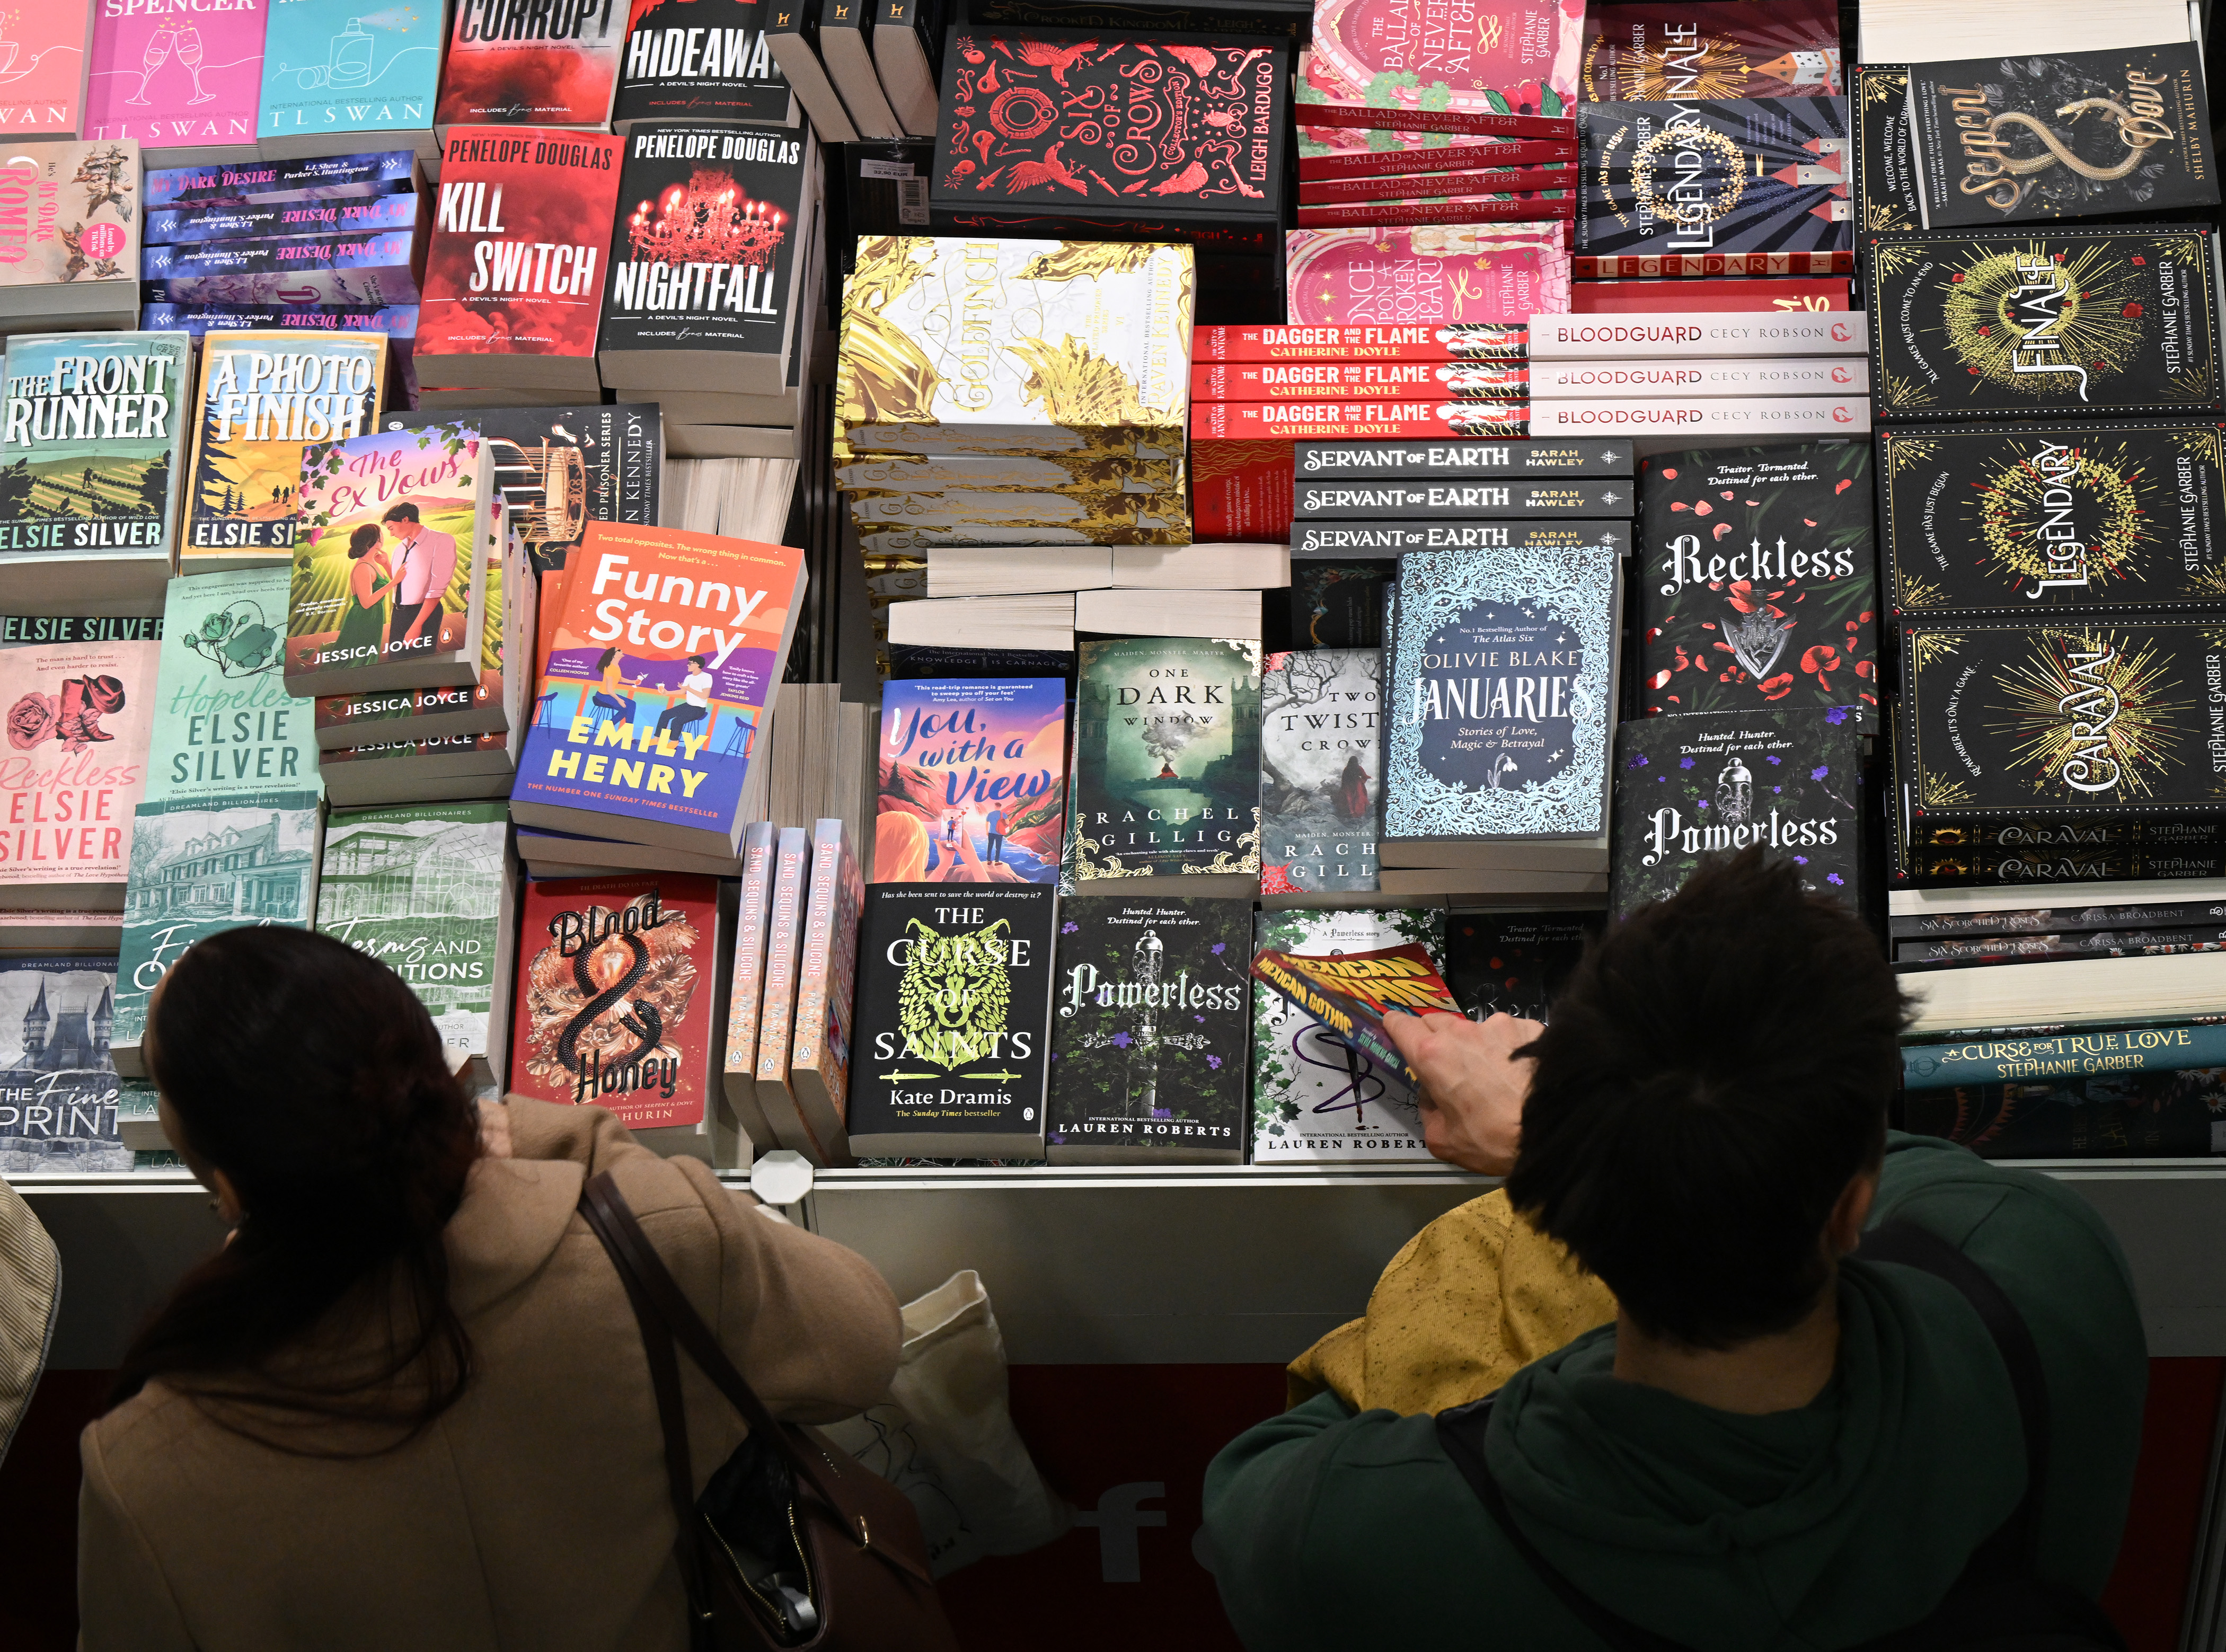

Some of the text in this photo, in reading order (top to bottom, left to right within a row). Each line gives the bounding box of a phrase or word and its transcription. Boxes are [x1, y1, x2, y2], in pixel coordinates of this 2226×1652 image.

[460, 0, 609, 43] CORRUPT
[626, 28, 782, 79] HIDEAWA
[270, 100, 332, 110] INTERNATIONAL
[270, 104, 422, 127] T L SWAN
[1059, 60, 1162, 175] SIX OF CROWS
[1250, 63, 1273, 181] LEIGH BARDUGO
[1338, 108, 1397, 120] BALLAD
[1408, 111, 1463, 125] NEVER
[1466, 114, 1517, 127] AFTER
[1374, 119, 1470, 133] STEPHANIE GARBER
[1937, 70, 2173, 209] Serpent Dove
[2180, 69, 2204, 180] SHELBY MAHURIN
[634, 135, 800, 165] PENELOPE DOUGLAS
[152, 170, 277, 194] MY DARK DESIRE
[1665, 102, 1713, 249] LEGENDARY
[30, 181, 59, 242] MY DARK
[437, 182, 505, 233] KILL
[469, 241, 596, 296] SWITCH
[613, 261, 776, 315] NIGHTFALL
[954, 242, 999, 412] GOLDFINCH
[1147, 256, 1174, 406] RAVEN KENNEDY
[2009, 255, 2088, 402] FINALE
[2159, 261, 2180, 373] STEPHANIE GARBER
[1262, 328, 1340, 344] DAGGER
[1366, 328, 1429, 343] FLAME
[1271, 347, 1400, 357] CATHERINE DOYLE
[1558, 326, 1823, 345] BLOODGUARD CECY ROBSON
[8, 355, 176, 399] THE FRONT
[211, 354, 373, 401] A PHOTO
[4, 393, 170, 448] RUNNER
[218, 393, 365, 441] FINISH
[348, 449, 402, 479] The
[1304, 447, 1509, 471] SERVANT OF EARTH
[1525, 458, 1585, 466] HAWLEY
[329, 451, 461, 518] Ex Vows
[0, 523, 160, 550] ELSIE SILVER
[196, 524, 263, 546] ELSIE
[2026, 439, 2088, 599] LEGENDARY
[613, 536, 633, 544] total
[634, 538, 674, 550] opposites.
[693, 546, 717, 557] wrong
[719, 548, 739, 560] thing
[750, 555, 786, 566] common.
[1660, 534, 1854, 596] Reckless
[591, 553, 767, 627] Funny
[313, 635, 433, 665] JESSICA JOYCE
[588, 599, 746, 670] Story
[1150, 669, 1188, 678] ONE
[1424, 651, 1578, 668] OLIVIE BLAKE
[1117, 684, 1224, 705] DARK
[1403, 675, 1591, 723] JANUARIES
[188, 710, 289, 746] ELSIE
[888, 708, 986, 757] You,
[1124, 716, 1214, 726] WINDOW
[1458, 727, 1538, 737] Stories of Love,
[2059, 643, 2121, 791] CARAVAL
[567, 715, 709, 761] EMILY
[919, 737, 1024, 766] with a
[1450, 738, 1545, 750] Magic & Betrayal
[171, 747, 299, 783] SILVER
[547, 749, 708, 798] HENRY
[946, 765, 1052, 806] View
[1097, 808, 1238, 824] RACHEL
[1102, 830, 1232, 846] GILLIG
[550, 889, 668, 958] Blood
[808, 843, 834, 977] SAND, SEQUINS & SILICONE
[935, 907, 984, 924] THE
[1921, 914, 2042, 931] SIX SCORCHED ROSES
[2071, 910, 2184, 923] CARISSA BROADBENT
[887, 939, 1031, 967] CURSE
[935, 988, 974, 1007] OF
[1060, 963, 1242, 1018] Powerless
[1258, 957, 1354, 1040] MEXICAN GOTHIC
[874, 1031, 1031, 1059] SAINTS
[1941, 1030, 2192, 1063] A CURSE FOR TRUE LOVE
[575, 1049, 677, 1103] Honey
[889, 1089, 1012, 1105] Kate Dramis
[1059, 1124, 1231, 1137] LAUREN ROBERTS
